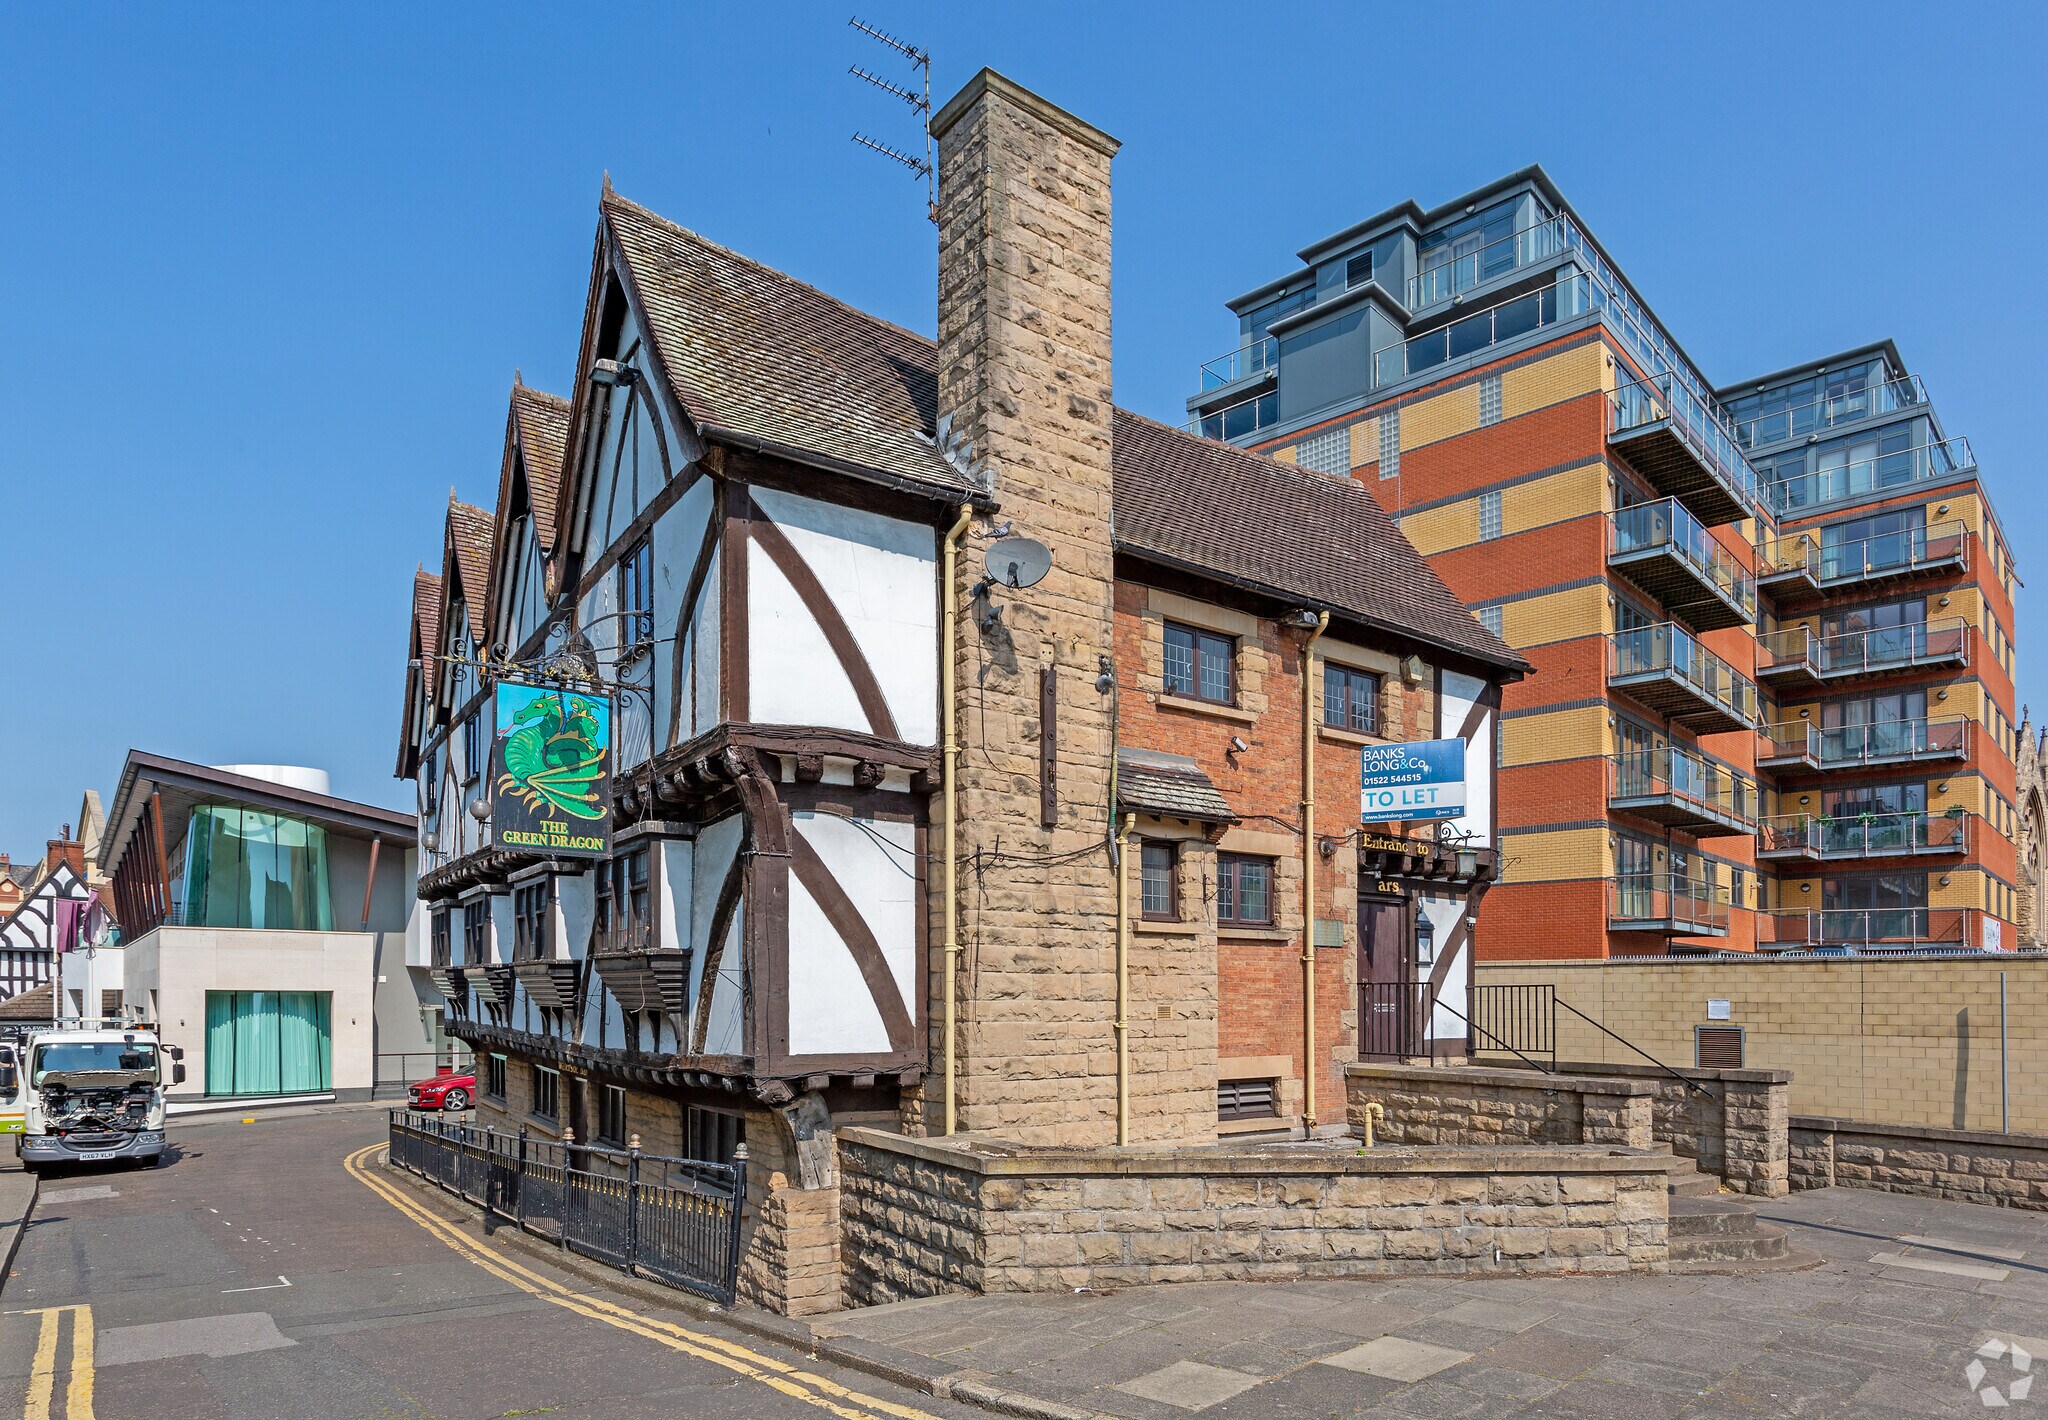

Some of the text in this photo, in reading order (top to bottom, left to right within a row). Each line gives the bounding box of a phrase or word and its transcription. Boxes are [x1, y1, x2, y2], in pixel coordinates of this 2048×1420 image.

[1364, 747, 1405, 761] BANKS
[1364, 773, 1421, 785] 01522 544515
[1366, 788, 1439, 808] TO LET
[1365, 812, 1413, 820] www.bankslong.com
[540, 820, 569, 834] THE
[503, 831, 605, 851] GREEN DRAGON
[1417, 842, 1429, 855] to
[1378, 881, 1400, 892] ars
